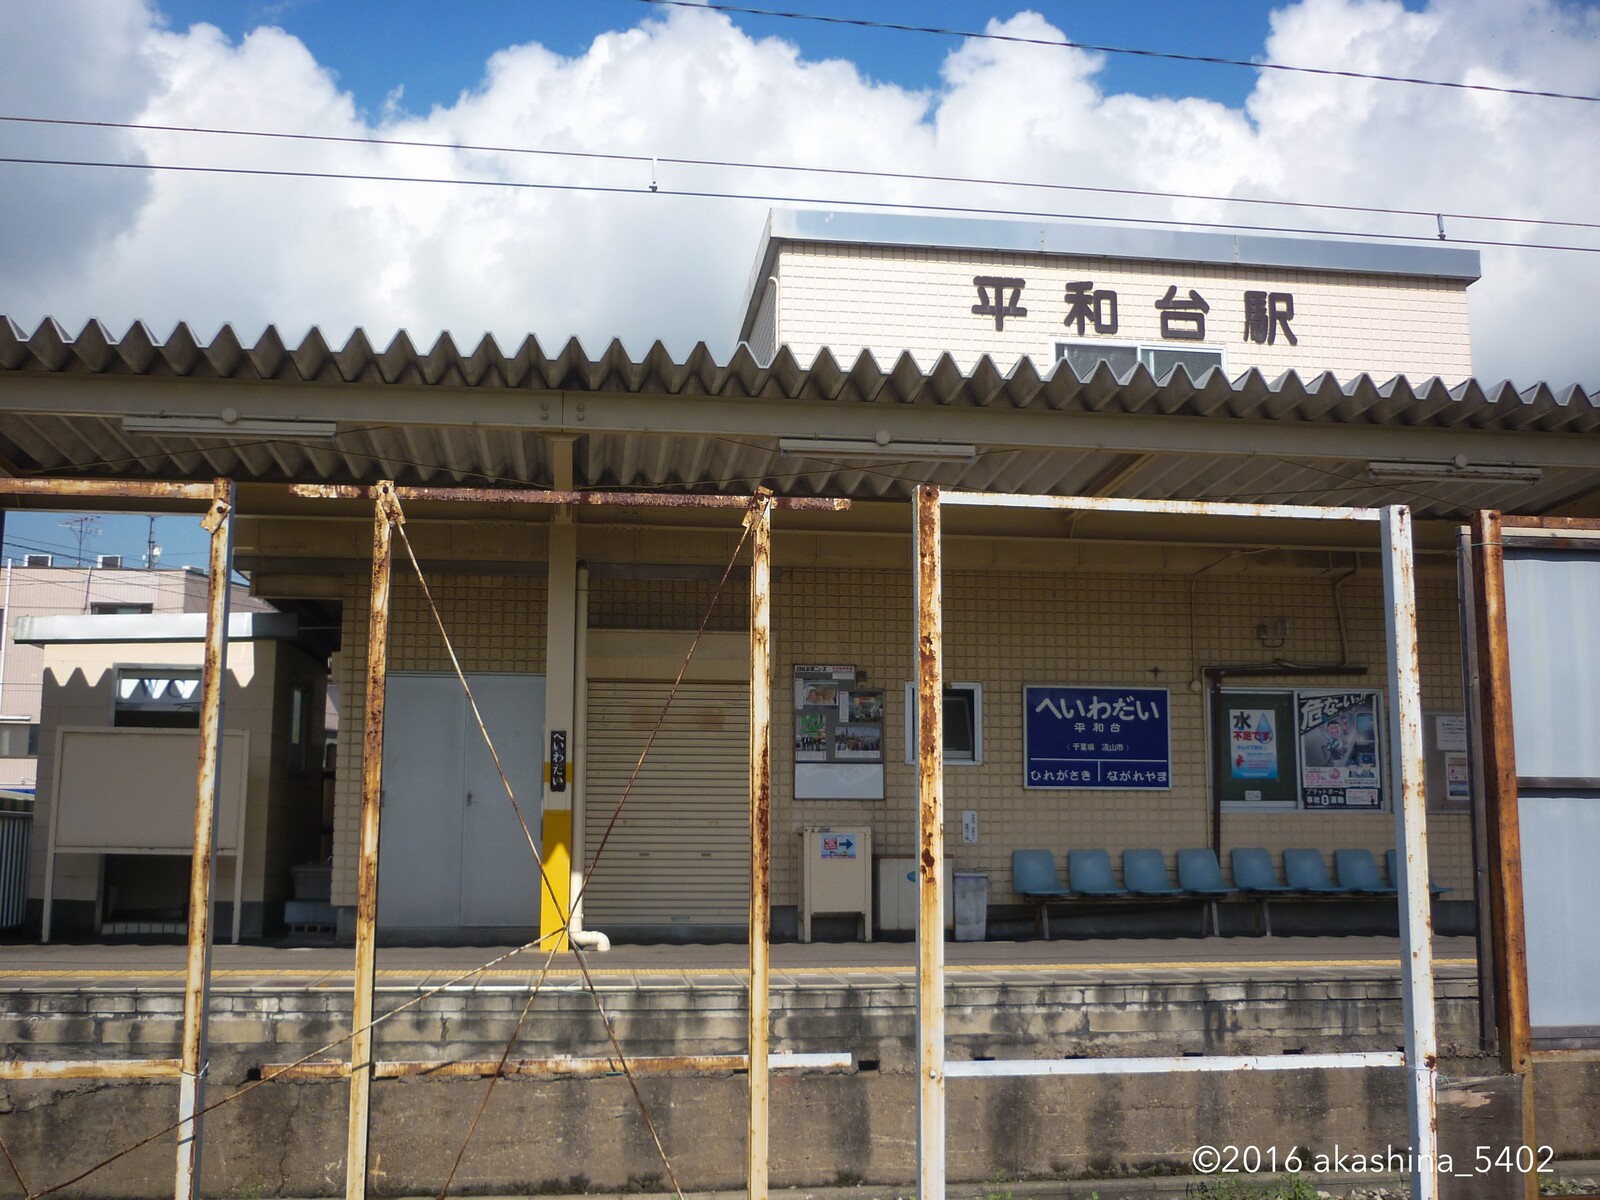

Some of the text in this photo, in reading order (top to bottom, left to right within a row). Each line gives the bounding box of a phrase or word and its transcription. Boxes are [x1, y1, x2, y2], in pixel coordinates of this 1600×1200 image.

[971, 276, 1298, 347] 平和台駅
[1035, 695, 1160, 721] へいわだい
[1074, 722, 1121, 733] 平和台
[1232, 711, 1252, 729] 水
[1030, 769, 1168, 783] ひれがさき ながれやま
